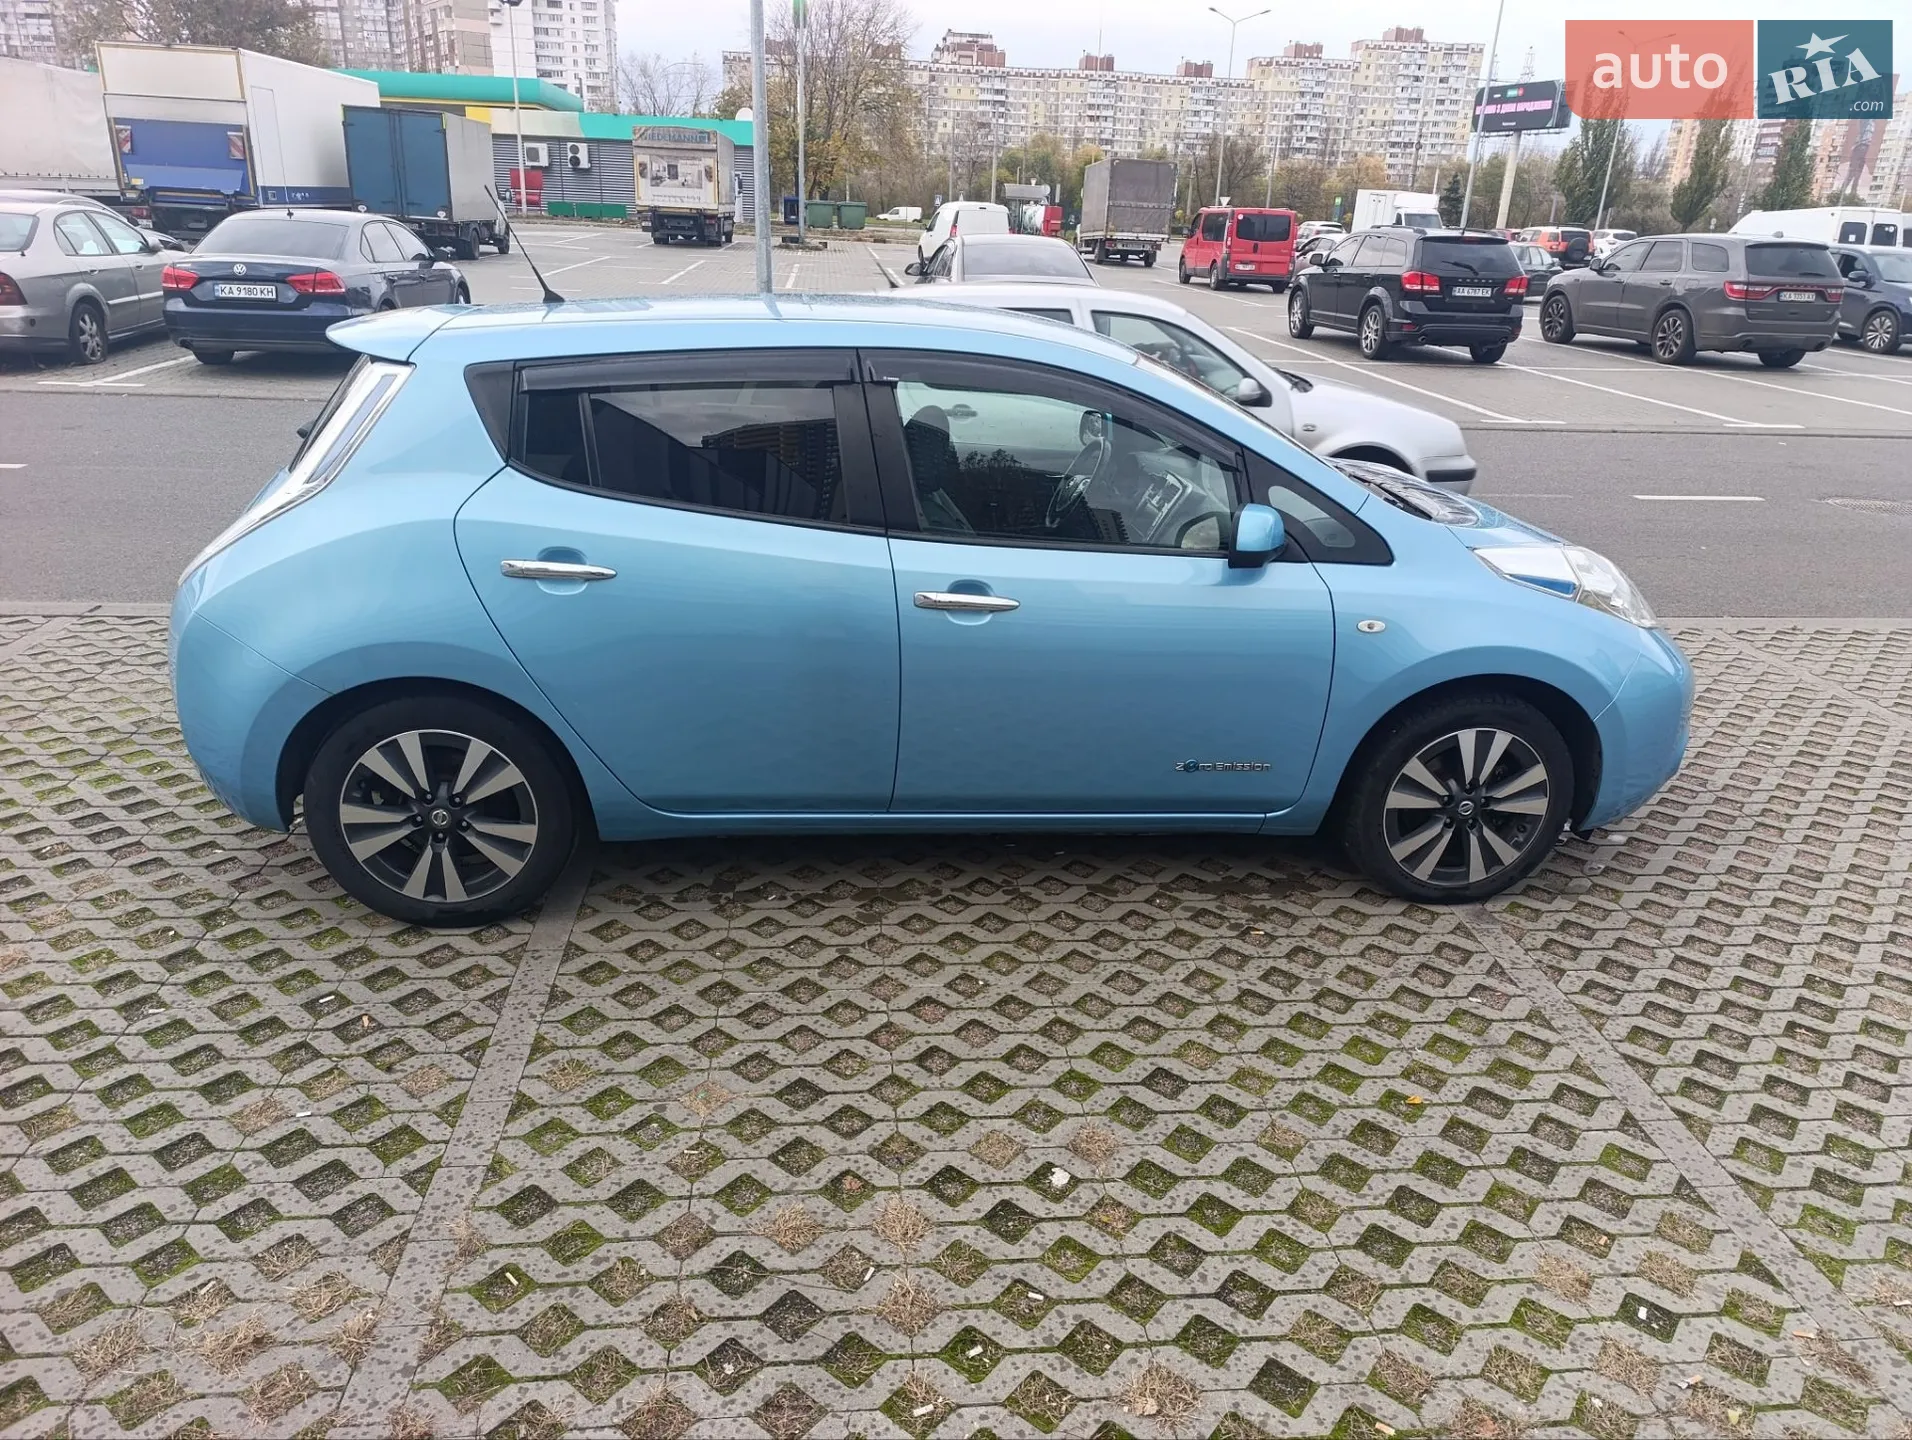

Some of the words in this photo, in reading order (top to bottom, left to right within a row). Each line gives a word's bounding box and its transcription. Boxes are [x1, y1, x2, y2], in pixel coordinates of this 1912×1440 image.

[220, 286, 234, 296] KA
[236, 287, 258, 296] 9180
[260, 287, 274, 297] KH
